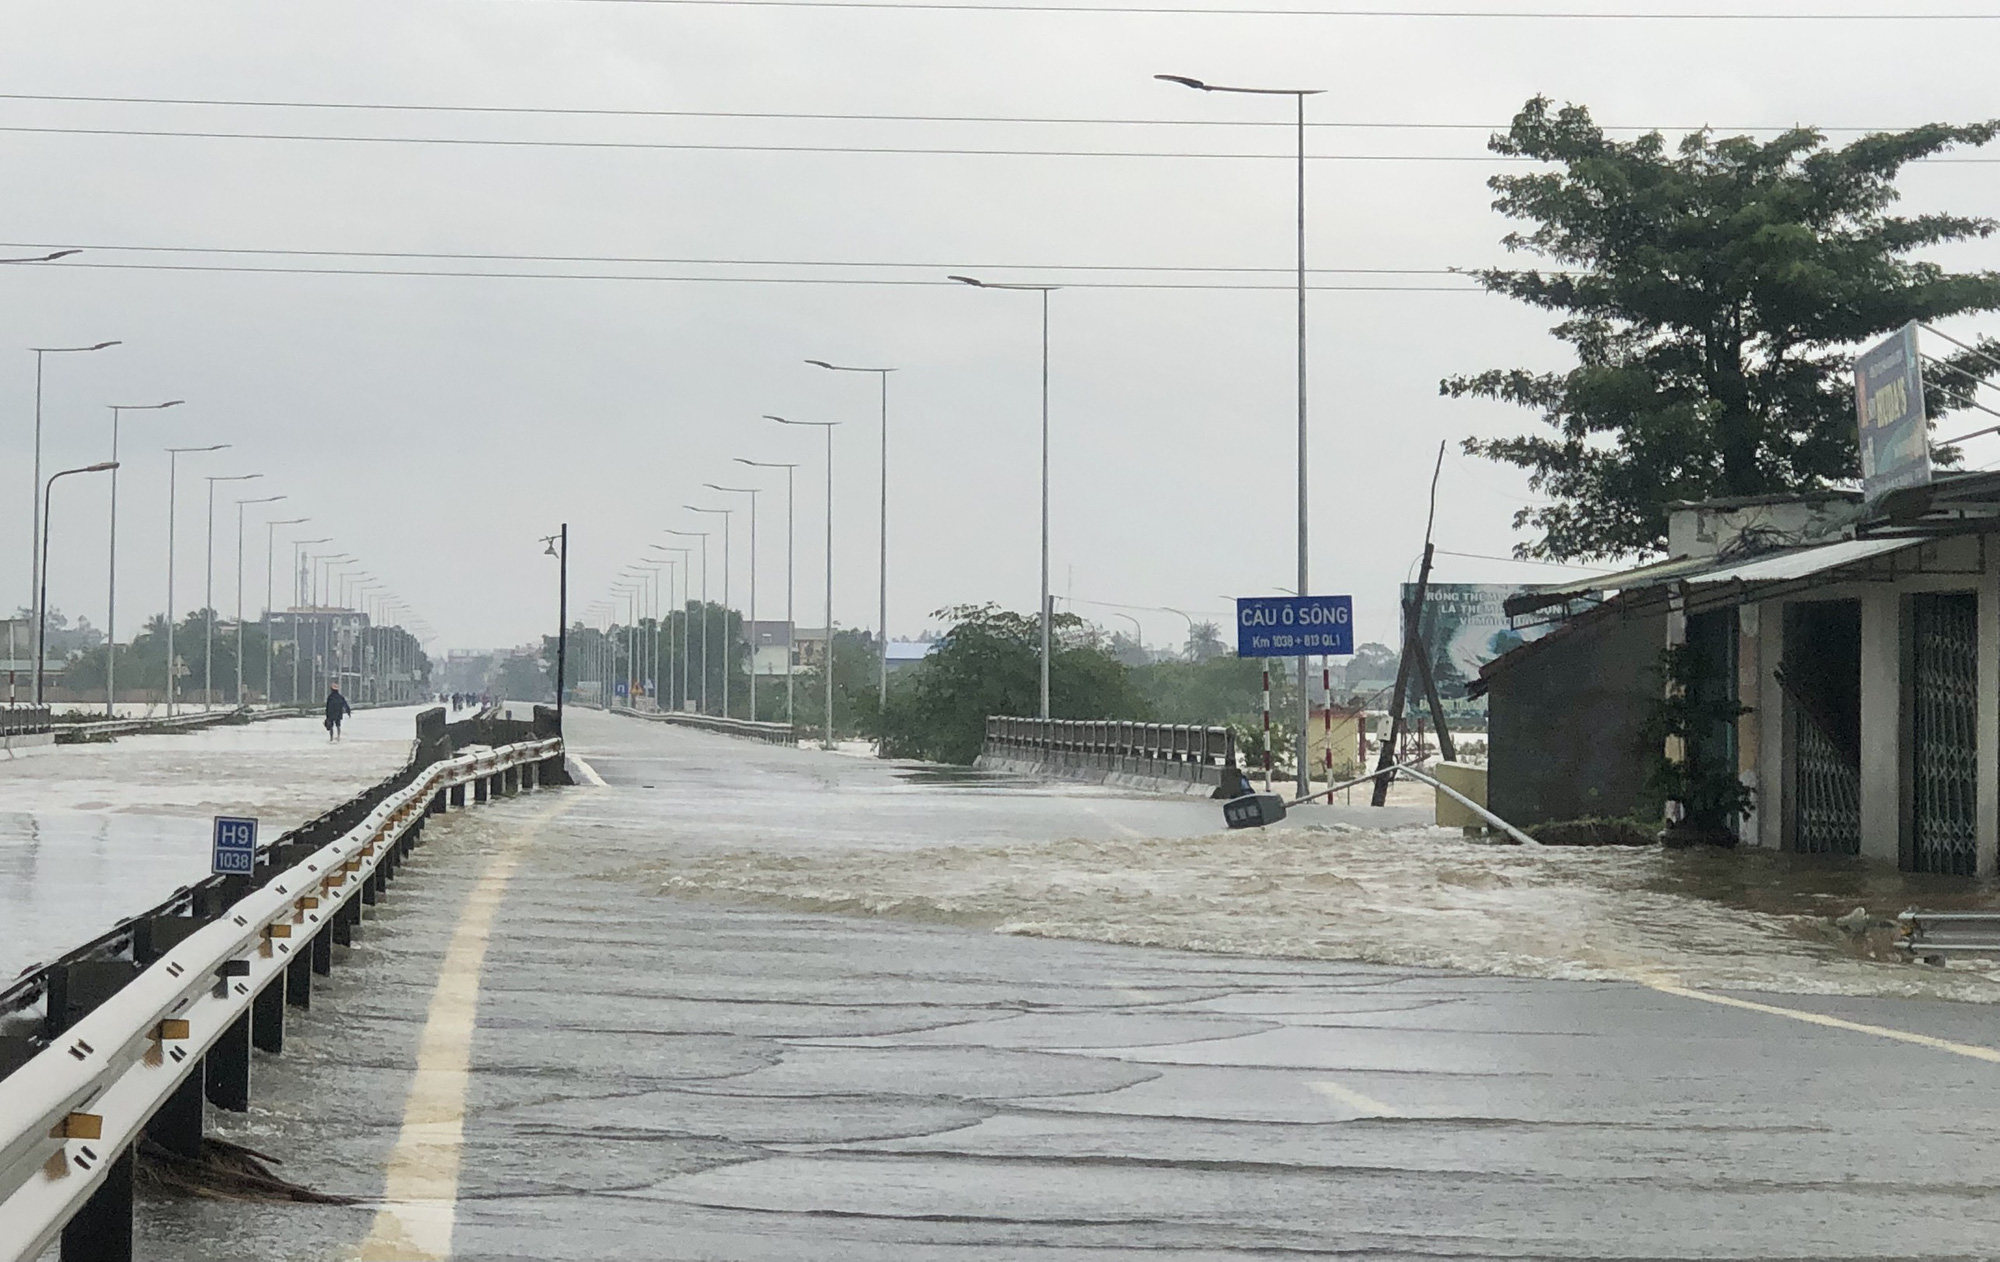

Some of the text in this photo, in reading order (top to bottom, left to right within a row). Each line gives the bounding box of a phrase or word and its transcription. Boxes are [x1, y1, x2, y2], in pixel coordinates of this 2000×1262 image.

[1282, 604, 1294, 625] Ô
[1299, 603, 1348, 625] SÔNG
[1252, 636, 1270, 648] Km
[1272, 635, 1294, 648] 1038
[1304, 634, 1320, 647] 813
[1322, 634, 1340, 647] QL1
[222, 825, 249, 844] H9
[219, 853, 249, 869] 1038
